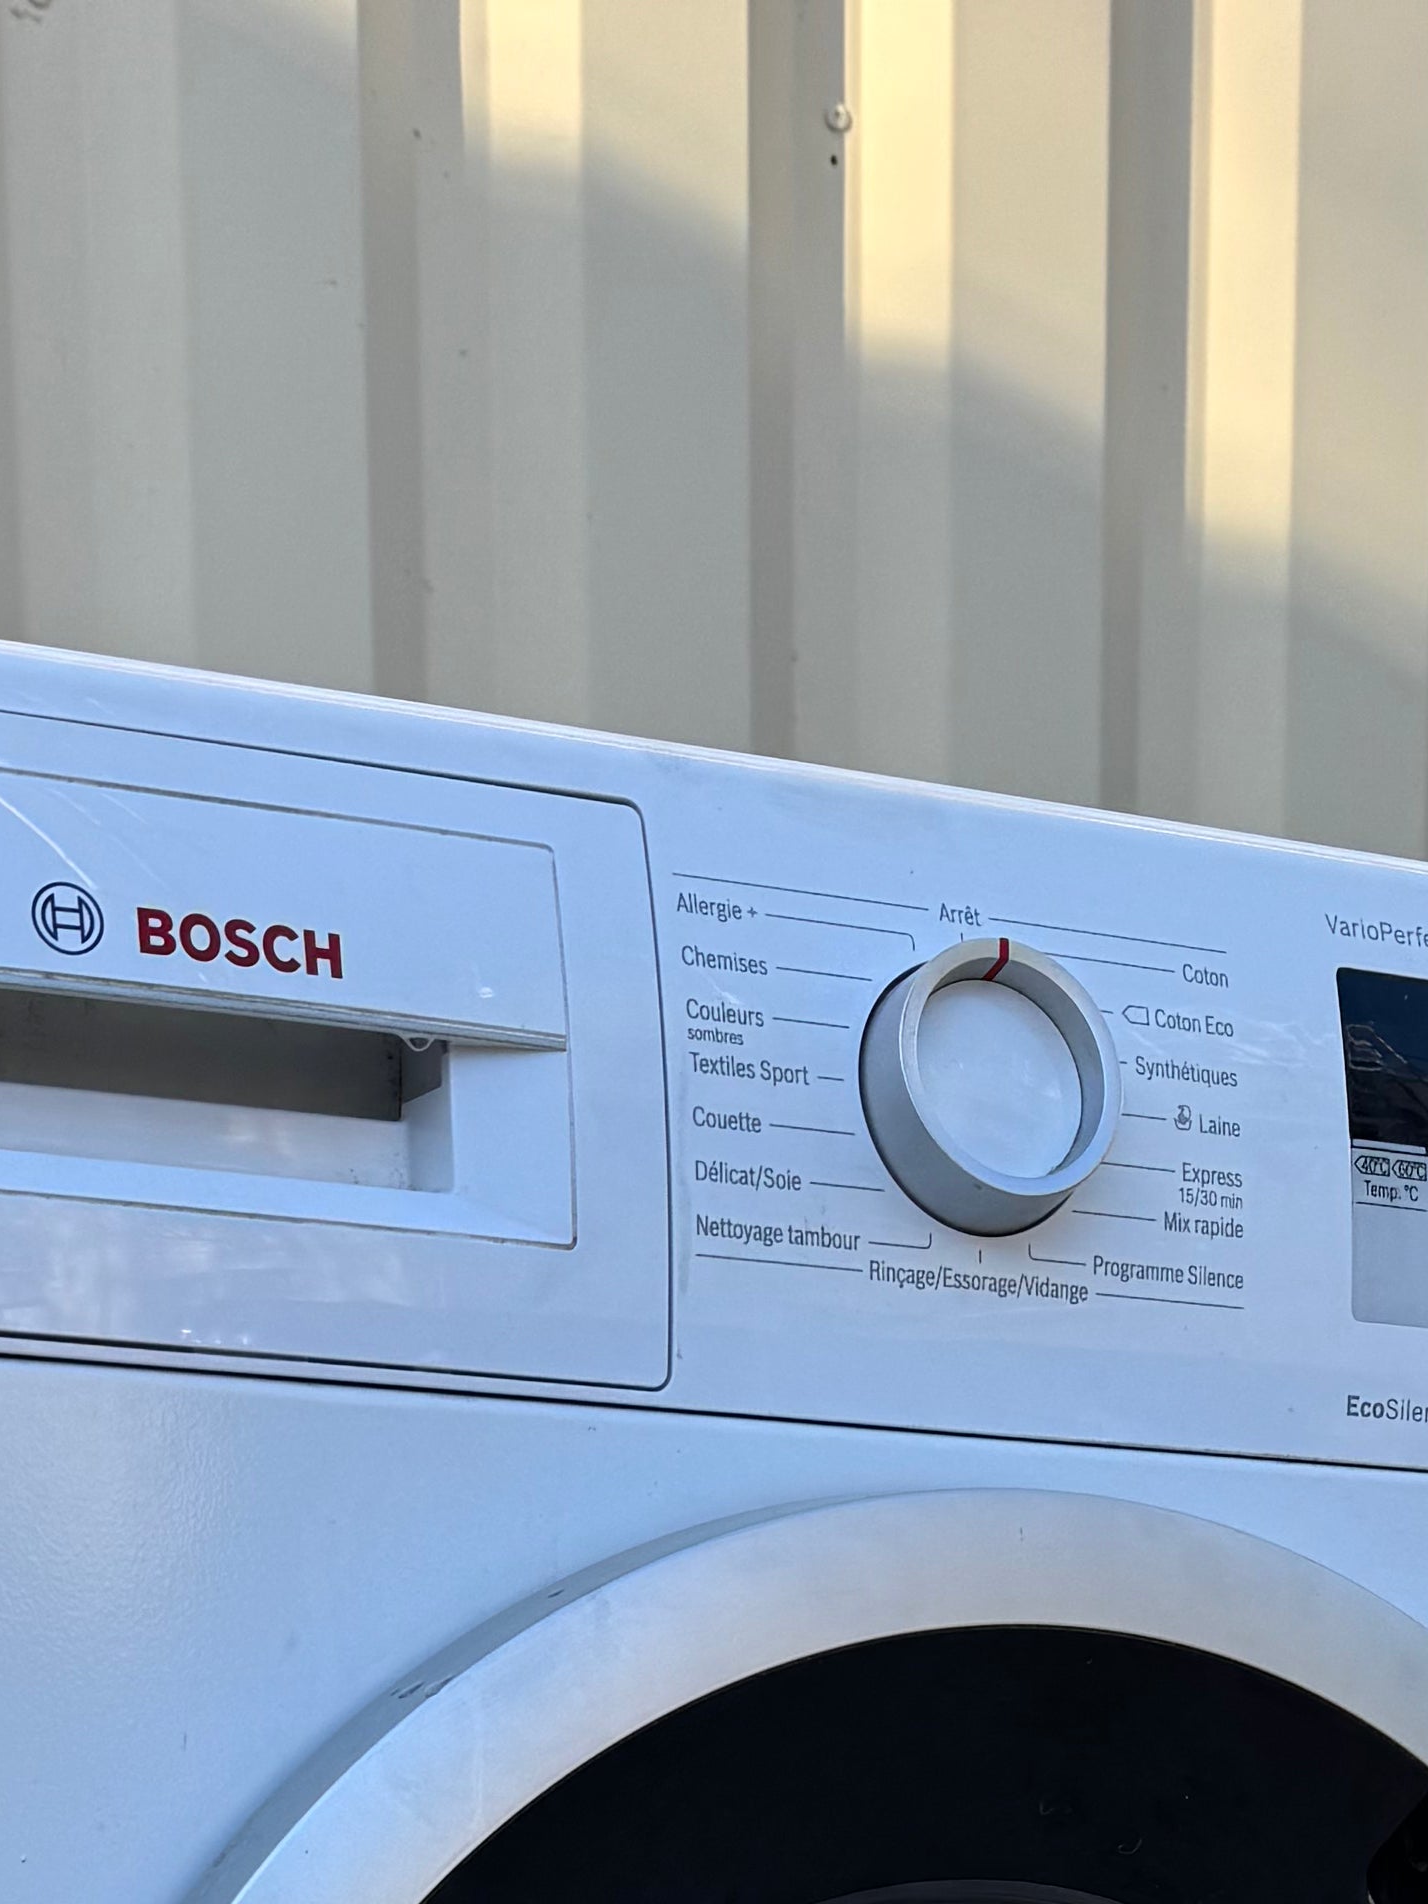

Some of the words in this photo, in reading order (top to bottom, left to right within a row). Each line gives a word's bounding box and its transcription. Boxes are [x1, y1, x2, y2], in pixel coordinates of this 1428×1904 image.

[676, 892, 743, 923] Allergie
[746, 906, 758, 918] +
[939, 902, 982, 927] Arrêt
[135, 906, 344, 980] BOSCH
[680, 945, 769, 976] Chemises
[1182, 963, 1229, 989] Coton
[685, 998, 764, 1027] Couleurs
[1154, 1008, 1202, 1033] Coton
[1205, 1014, 1234, 1038] Eco
[687, 1026, 744, 1046] sombres
[688, 1051, 756, 1080] Textiles
[760, 1059, 810, 1087] Sport
[1135, 1055, 1238, 1088] Synthétiques
[692, 1105, 762, 1134] Couette
[1199, 1113, 1241, 1138] Laine
[694, 1159, 803, 1192] Délicat/Soie
[1182, 1161, 1243, 1188] Express
[1178, 1187, 1218, 1207] 15/30
[1220, 1193, 1243, 1210] min
[1363, 1180, 1401, 1202] Temp.
[1403, 1184, 1419, 1201] °C
[696, 1213, 784, 1247] Nettoyage
[787, 1224, 861, 1251] tambour
[1164, 1211, 1191, 1233] Mix
[1194, 1216, 1244, 1240] rapide
[869, 1259, 1089, 1305] Rinçage/Essorage/Vidange
[1092, 1255, 1184, 1286] Programme
[1187, 1265, 1245, 1290] Silence
